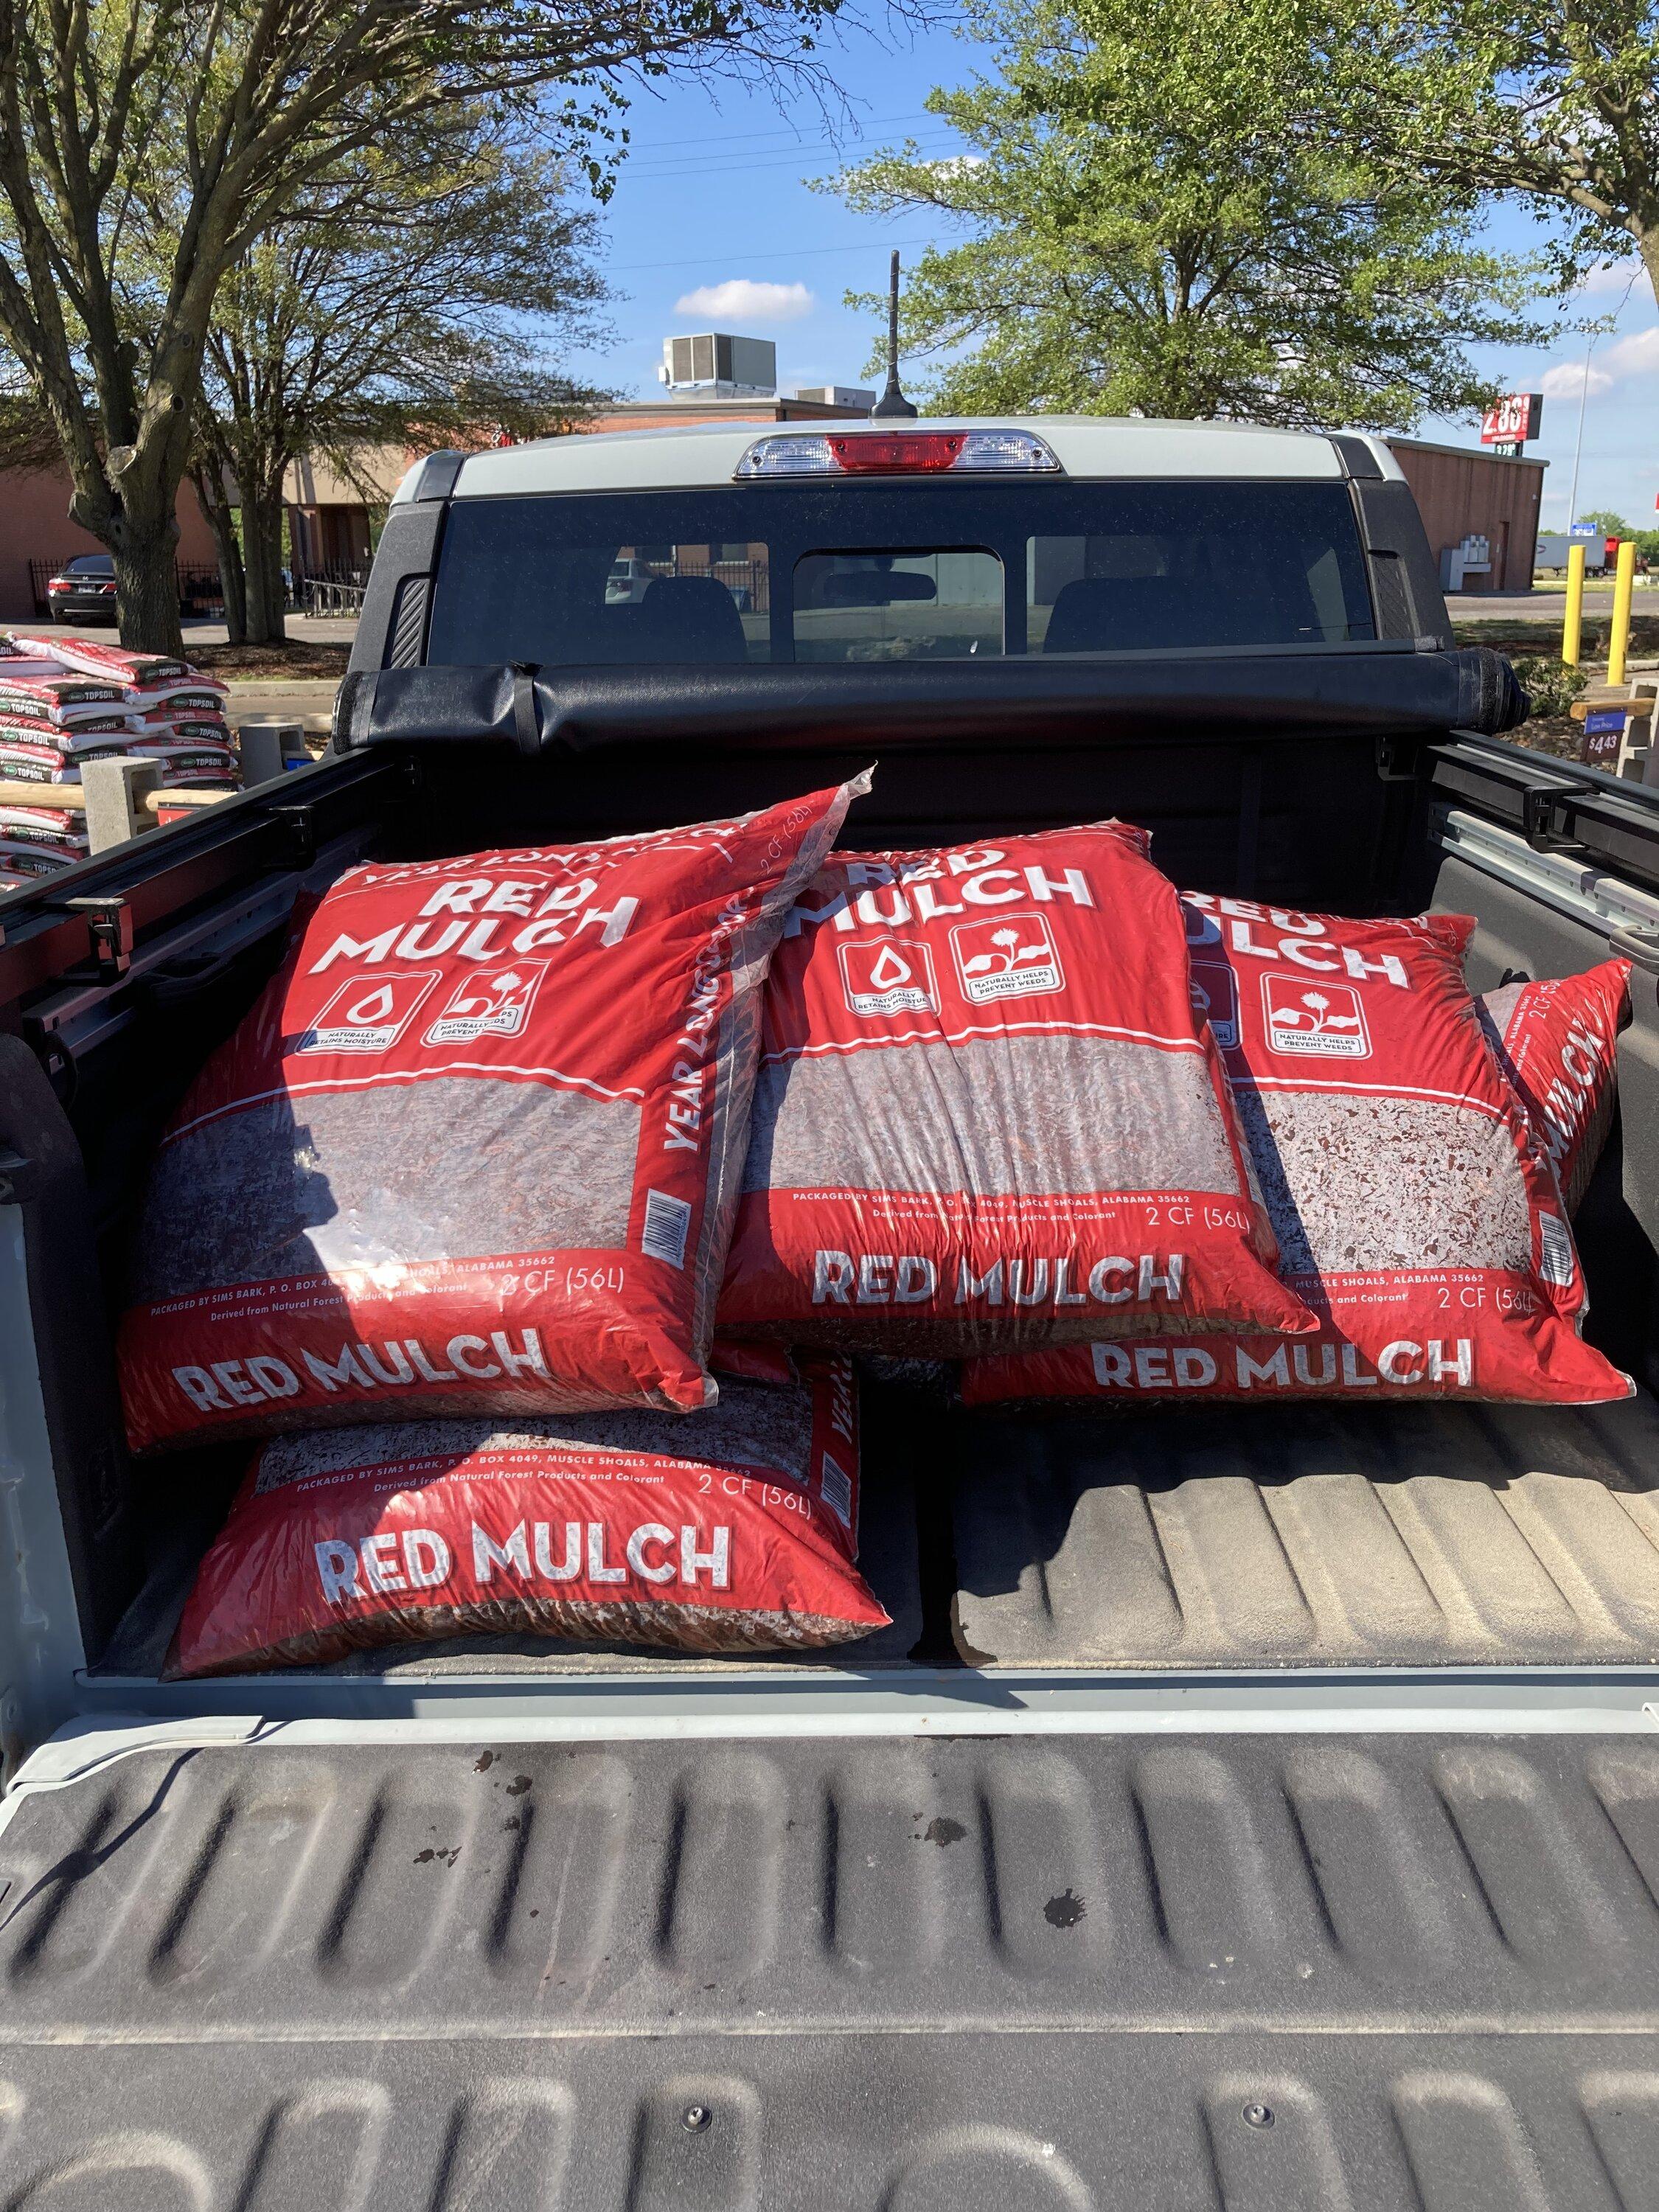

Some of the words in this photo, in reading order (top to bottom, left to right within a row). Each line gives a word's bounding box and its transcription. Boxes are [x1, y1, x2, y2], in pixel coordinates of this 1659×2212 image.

[159, 667, 181, 676] TOPSOIL
[85, 690, 115, 700] TOPSOIL
[11, 703, 41, 717] TOPSOIL
[188, 699, 215, 709] TOPSOIL
[19, 732, 50, 746] TOPSOIL
[199, 727, 223, 740] TOPSOIL
[195, 758, 223, 766] TOPSOIL
[17, 768, 45, 782] TOPSOIL
[29, 832, 59, 844] TOPSOIL
[759, 858, 773, 876] 2
[768, 830, 785, 860] CF
[845, 849, 1006, 887] RED
[417, 878, 599, 919] RED
[783, 866, 1094, 939] MULCH
[1180, 889, 1326, 936] RED
[308, 897, 640, 975] MULCH
[1186, 914, 1409, 990] ULCH
[974, 976, 1022, 989] NATURALLY
[1023, 970, 1049, 980] HELPS
[980, 984, 1017, 995] PREVENT
[1018, 978, 1047, 987] WEEDS
[858, 1001, 891, 1009] RETAINS
[892, 996, 928, 1006] MOISTUR
[872, 992, 916, 1004] NATURALLY
[1533, 996, 1551, 1009] CF
[1528, 1010, 1547, 1020] 2
[441, 1020, 489, 1031] NATURALLY
[442, 1028, 479, 1037] PREVENT
[1509, 1012, 1525, 1039] ALABAMA
[309, 1037, 343, 1046] RETAINS
[344, 1037, 387, 1045] MOISTURE
[328, 1032, 376, 1040] NATURALLY
[1279, 1034, 1327, 1043] NATURALLY
[1329, 1037, 1356, 1046] HELPS
[1284, 1040, 1321, 1048] PREVENT
[1322, 1043, 1353, 1051] WEEDS
[1517, 1034, 1532, 1059] Colorant
[1516, 1059, 1524, 1071] and
[664, 1060, 703, 1152] YEAR
[872, 1195, 897, 1203] SIMS
[901, 1196, 933, 1206] BARK,
[1054, 1197, 1099, 1207] SHOALS,
[1102, 1195, 1155, 1204] ALABAMA
[1158, 1194, 1190, 1203] 35662
[873, 1209, 913, 1218] Derived
[915, 1211, 939, 1220] from
[1050, 1214, 1069, 1222] and
[1071, 1211, 1116, 1221] Colorant
[1144, 1206, 1160, 1226] 2
[1168, 1206, 1194, 1225] CF
[1203, 1206, 1250, 1234] (56L)
[456, 1260, 514, 1273] ALABAMA
[518, 1256, 555, 1268] 35662
[500, 1273, 520, 1296] 2
[524, 1270, 555, 1293] CF
[566, 1267, 624, 1295] (56L)
[812, 1250, 939, 1304] RED
[953, 1253, 1183, 1306] MULCH
[1295, 1278, 1338, 1289] MUSCLE
[1342, 1276, 1389, 1287] SHOALS,
[1393, 1274, 1447, 1284] ALABAMA
[1451, 1273, 1484, 1283] 35662
[150, 1301, 195, 1317] PACKAGED
[198, 1296, 210, 1307] BY
[212, 1292, 234, 1303] SIMS
[236, 1287, 265, 1298] BARK,
[269, 1285, 280, 1294] P.
[281, 1283, 292, 1293] O.
[296, 1280, 319, 1292] BOX
[211, 1307, 245, 1322] Derived
[246, 1305, 269, 1315] from
[272, 1298, 310, 1312] Natural
[313, 1295, 343, 1307] Forest
[395, 1288, 415, 1298] and
[1337, 1295, 1357, 1304] and
[1360, 1293, 1408, 1303] Colorant
[1437, 1287, 1451, 1309] 2
[1461, 1287, 1487, 1308] CF
[171, 1355, 300, 1412] RED
[300, 1328, 552, 1392] MULCH
[1091, 1341, 1217, 1389] RED
[1236, 1338, 1472, 1388] MULCH
[296, 1473, 355, 1492] PACKAGED
[359, 1470, 373, 1480] BY
[377, 1465, 404, 1476] SIMS
[408, 1461, 443, 1472] BARK,
[462, 1457, 474, 1465] O.
[479, 1455, 505, 1464] BOX
[509, 1455, 542, 1464] 4049,
[547, 1455, 594, 1465] MUSCLE
[599, 1457, 649, 1469] SHOALS,
[654, 1460, 712, 1470] ALABAMA
[716, 1465, 752, 1476] 35662
[375, 1480, 417, 1493] Derived
[420, 1477, 446, 1486] from
[450, 1471, 494, 1482] Natural
[498, 1470, 533, 1480] Forest
[537, 1470, 587, 1481] Products
[590, 1471, 612, 1481] and
[616, 1472, 664, 1484] Colorant
[698, 1473, 712, 1495] 2
[723, 1477, 753, 1495] CF
[762, 1483, 811, 1521] (56L)
[314, 1528, 451, 1605] RED
[471, 1518, 731, 1587] MULCH
